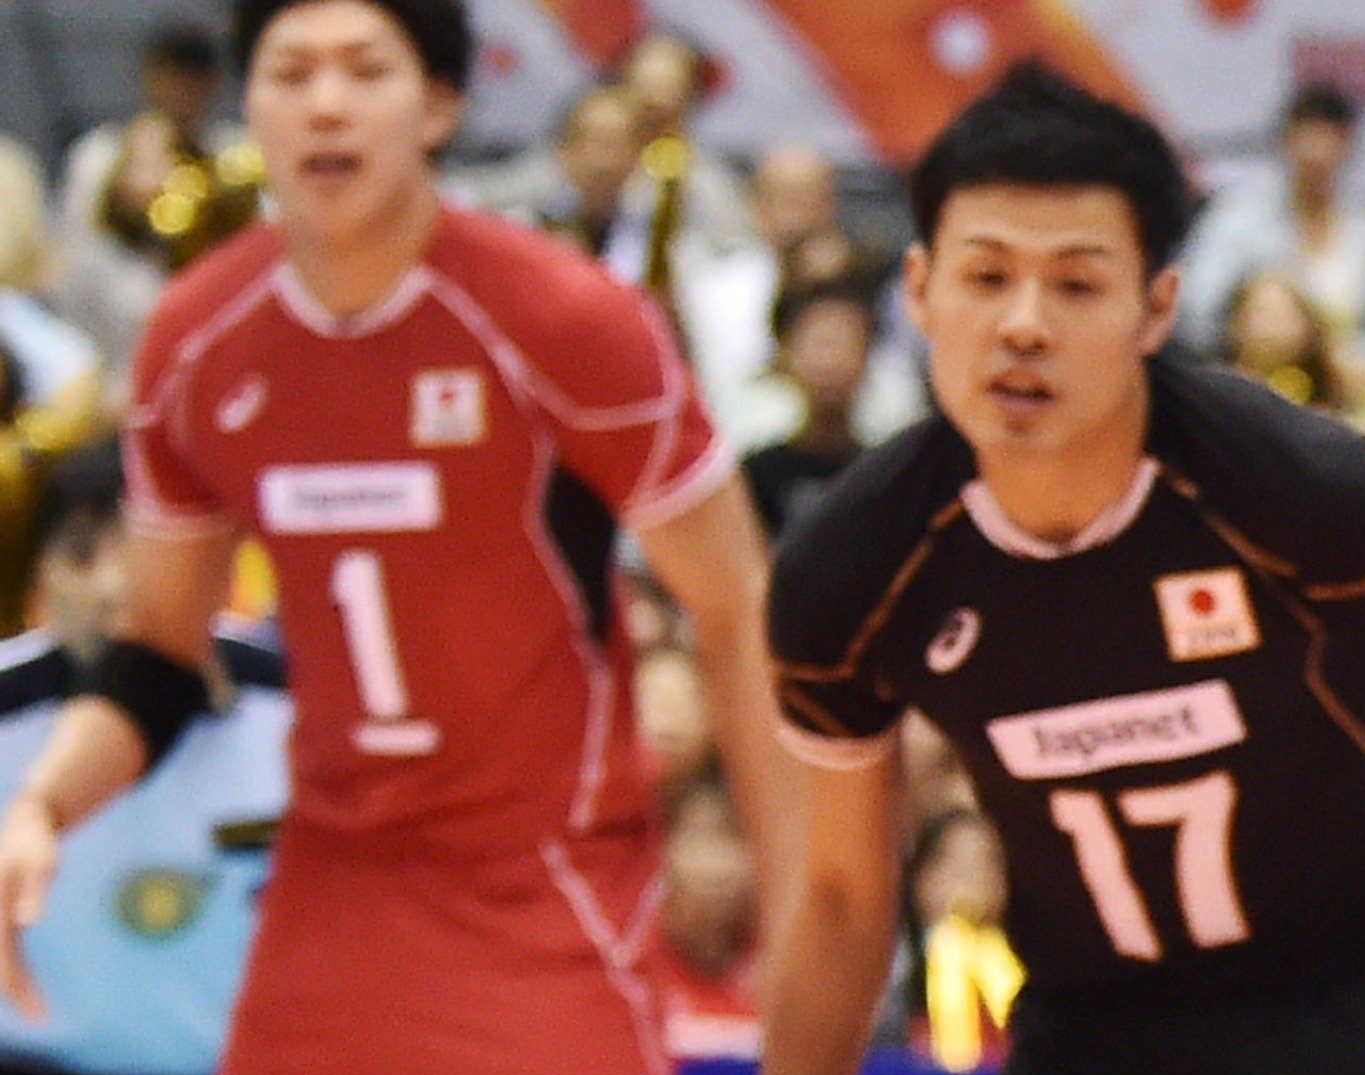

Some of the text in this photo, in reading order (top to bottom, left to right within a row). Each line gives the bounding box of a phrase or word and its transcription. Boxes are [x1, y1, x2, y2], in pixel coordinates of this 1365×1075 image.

[331, 548, 407, 719] 1
[1033, 705, 1197, 765] Japanet
[1047, 769, 1251, 962] 17
